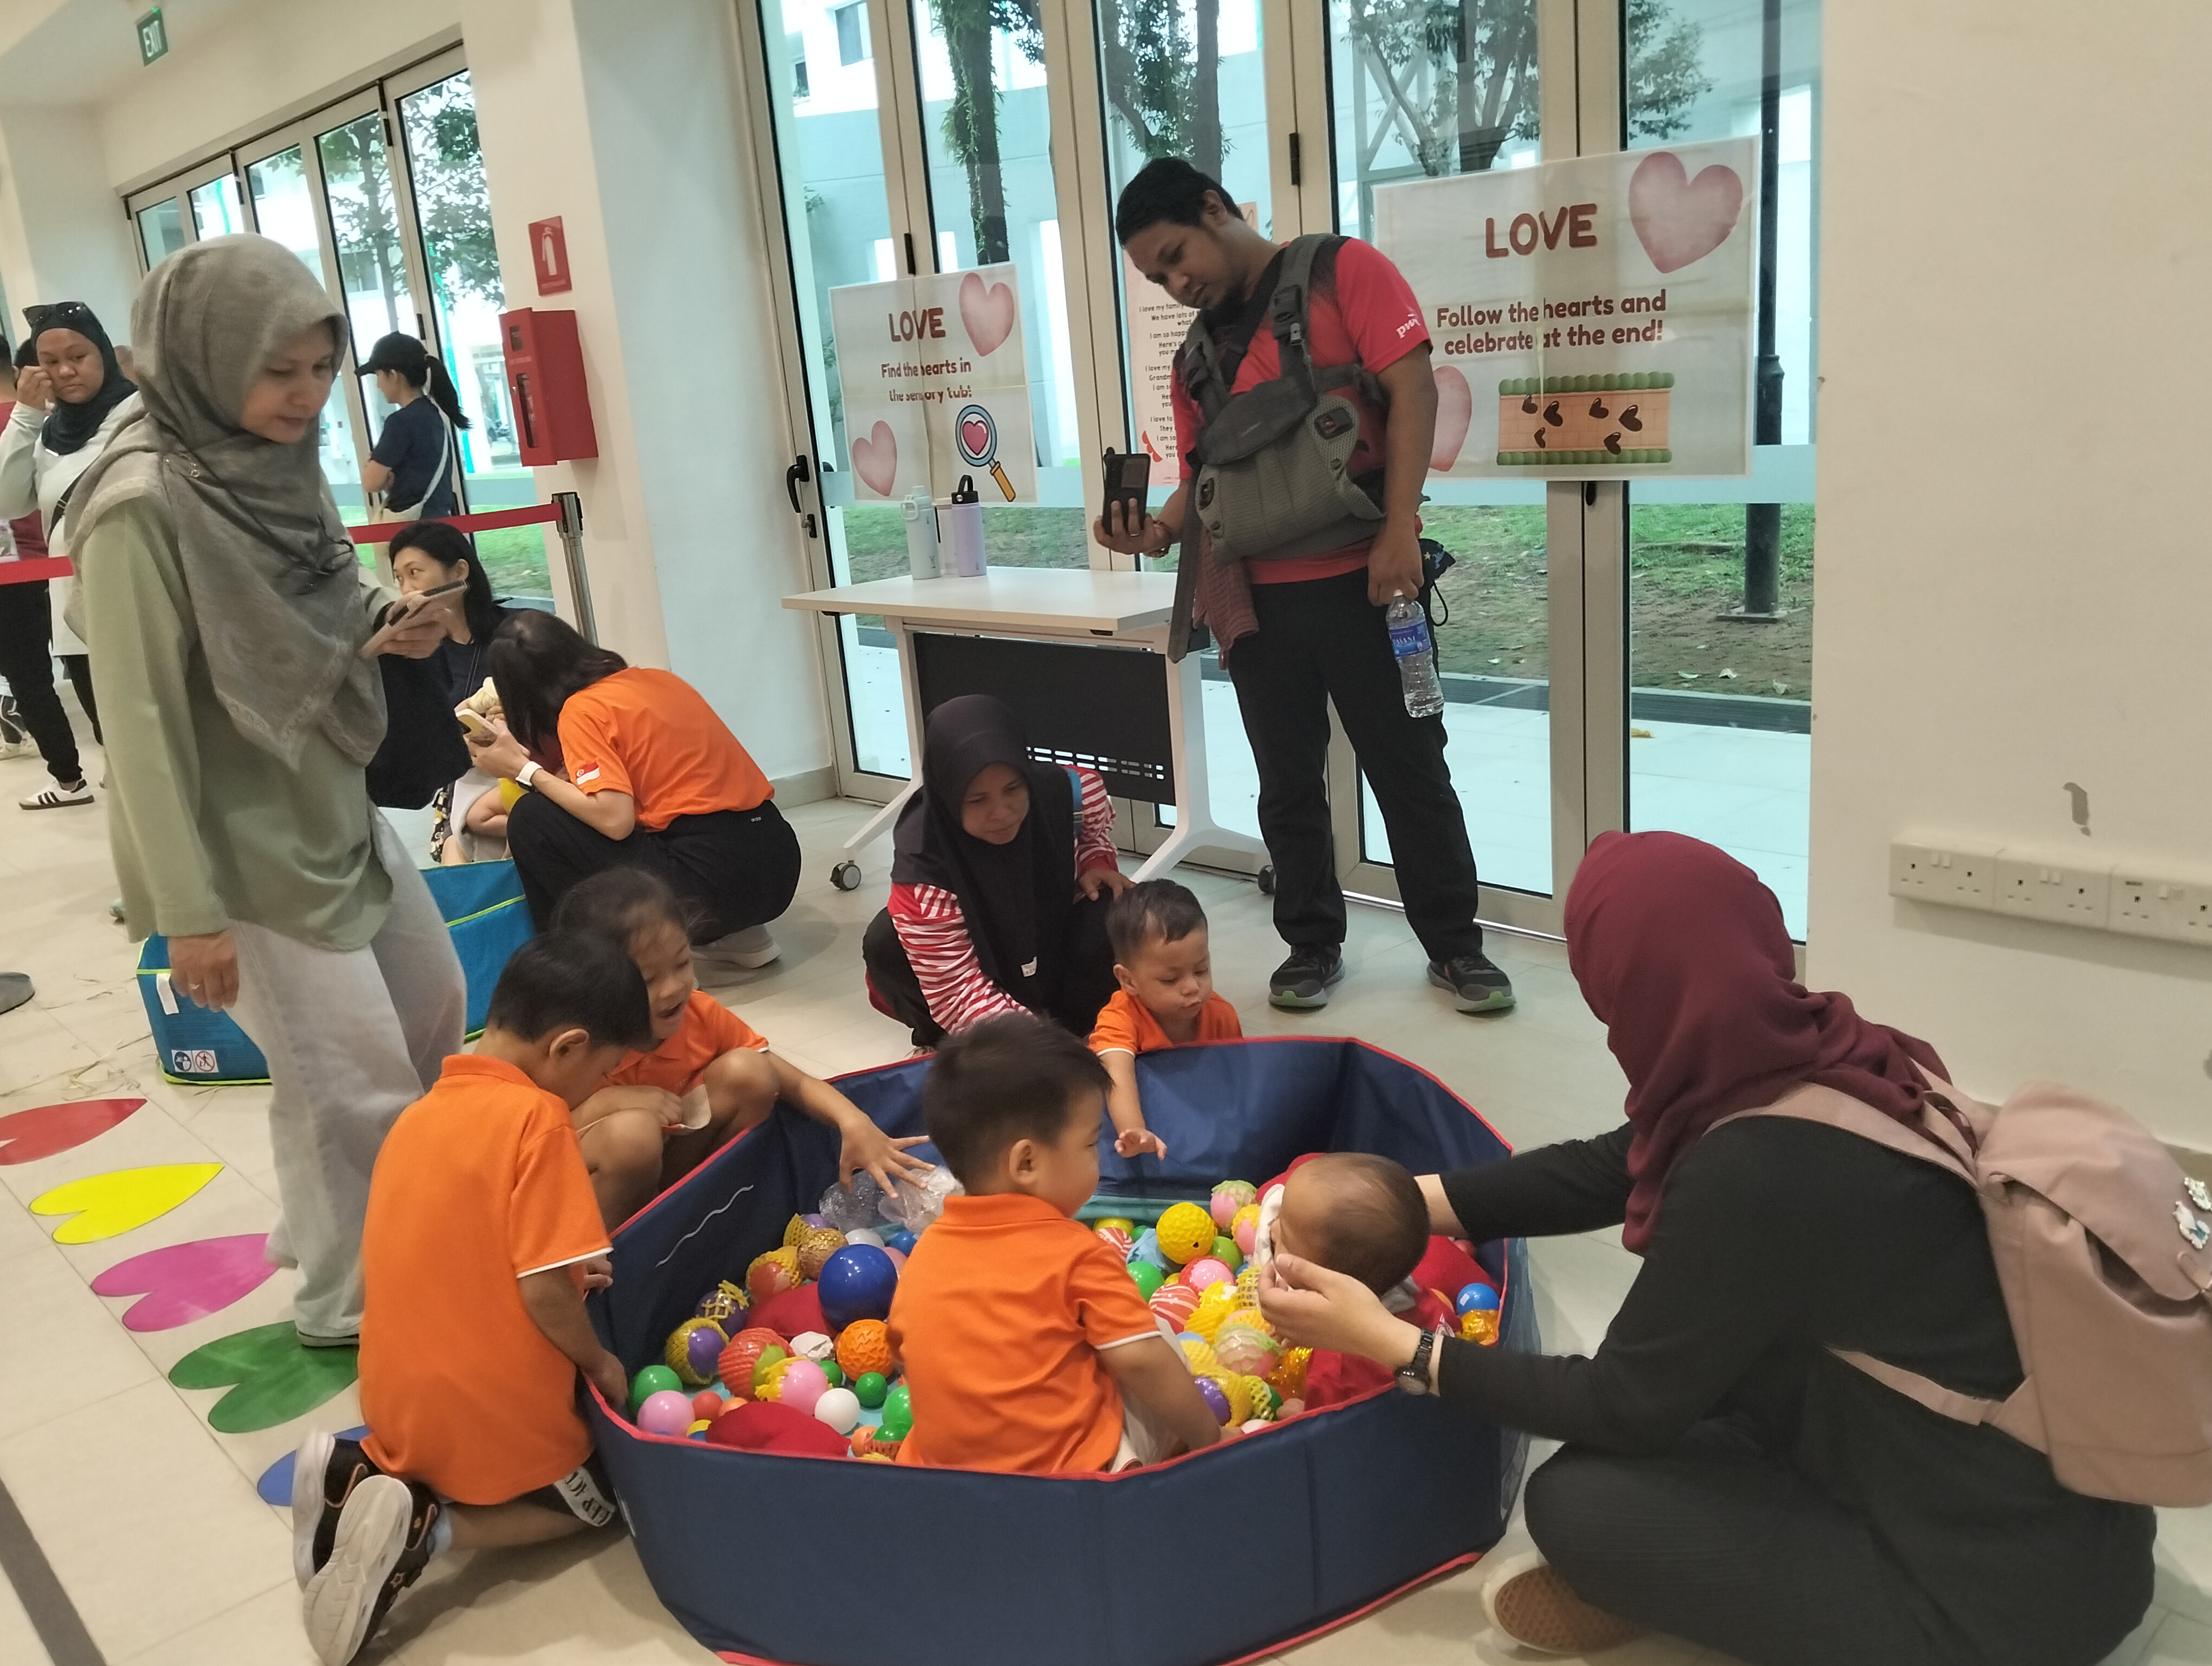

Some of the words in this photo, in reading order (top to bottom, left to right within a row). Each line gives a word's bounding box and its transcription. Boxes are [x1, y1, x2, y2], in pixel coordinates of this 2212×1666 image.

[143, 21, 162, 57] EXIT
[1486, 203, 1598, 258] LOVE
[889, 307, 946, 342] LOVE
[1437, 305, 1503, 328] Follow
[1508, 302, 1539, 323] the
[1544, 295, 1614, 319] hearts
[1621, 289, 1666, 313] and
[1444, 330, 1533, 355] celebrate
[1567, 324, 1605, 347] the
[1611, 319, 1663, 344] end!
[881, 363, 901, 378] Find
[903, 362, 918, 376] the
[960, 357, 972, 373] in
[889, 389, 904, 401] the
